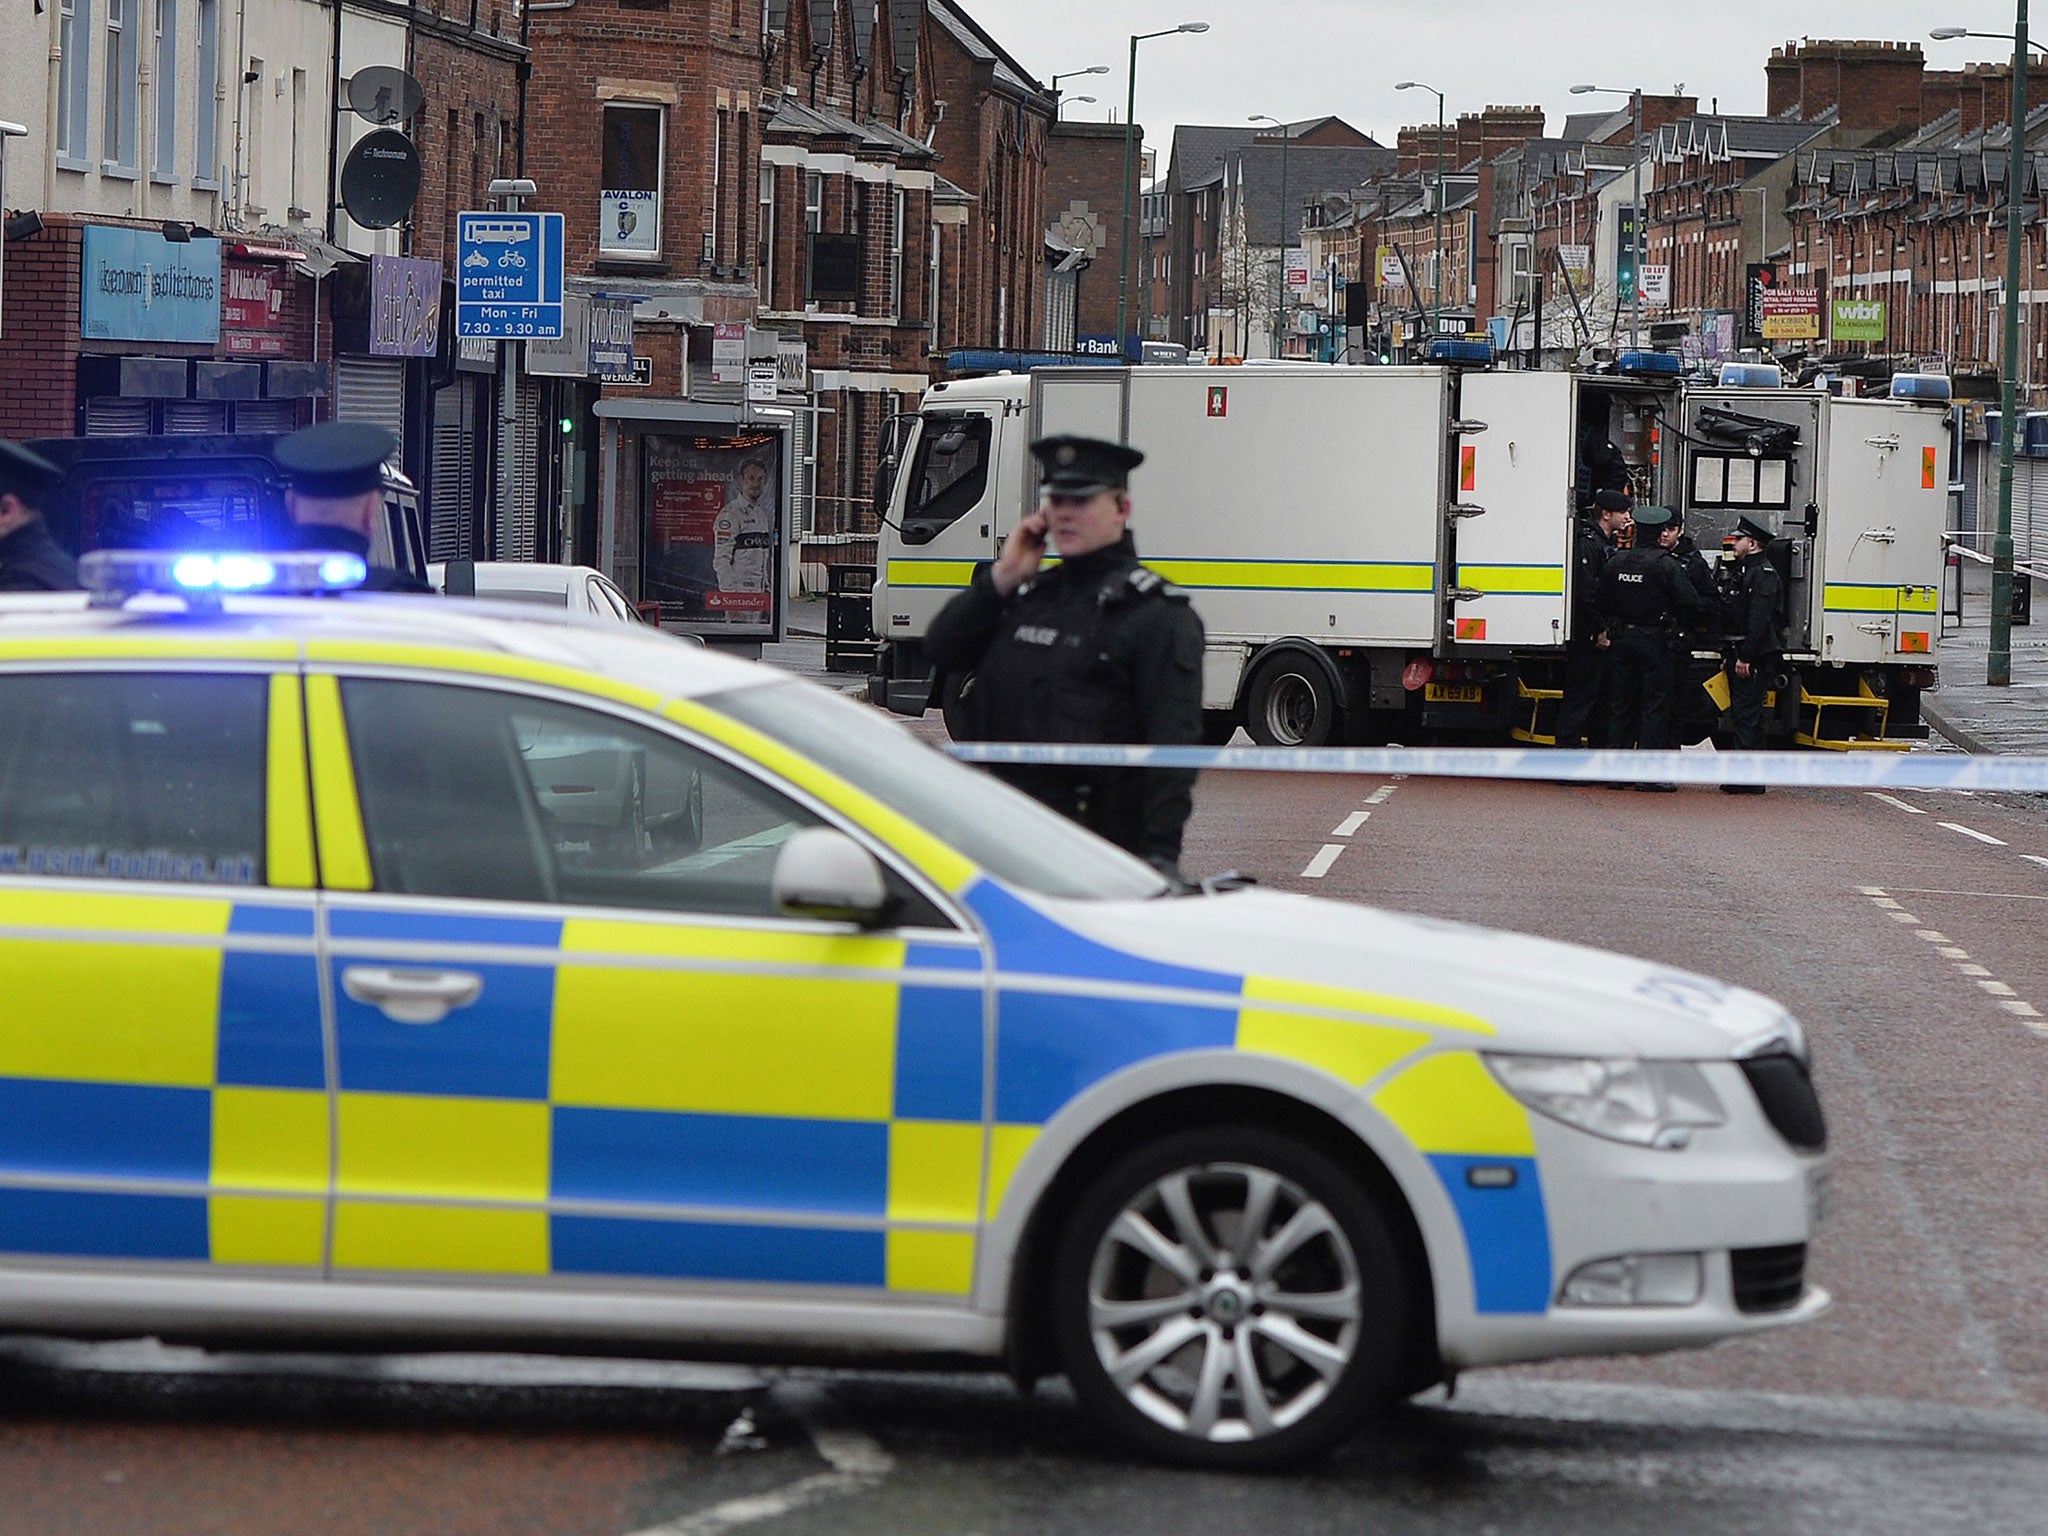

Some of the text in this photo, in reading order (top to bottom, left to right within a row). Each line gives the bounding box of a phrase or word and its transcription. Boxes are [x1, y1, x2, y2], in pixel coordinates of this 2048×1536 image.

[603, 190, 652, 200] AVALON
[152, 264, 214, 300] solicitors
[464, 276, 522, 287] permitted
[482, 288, 504, 299] taxi
[481, 307, 507, 318] Mon
[522, 308, 538, 319] Fri
[1838, 303, 1880, 319] wbf
[463, 323, 491, 334] 7.30
[504, 323, 533, 334] 9.30
[538, 326, 556, 335] am
[1439, 319, 1466, 333] DUO
[1088, 340, 1118, 354] Bank
[601, 373, 636, 382] AVENUE
[650, 456, 697, 468] Keep on
[651, 470, 734, 483] getting ahead
[1618, 573, 1643, 582] POLICE
[723, 596, 764, 606] Santander
